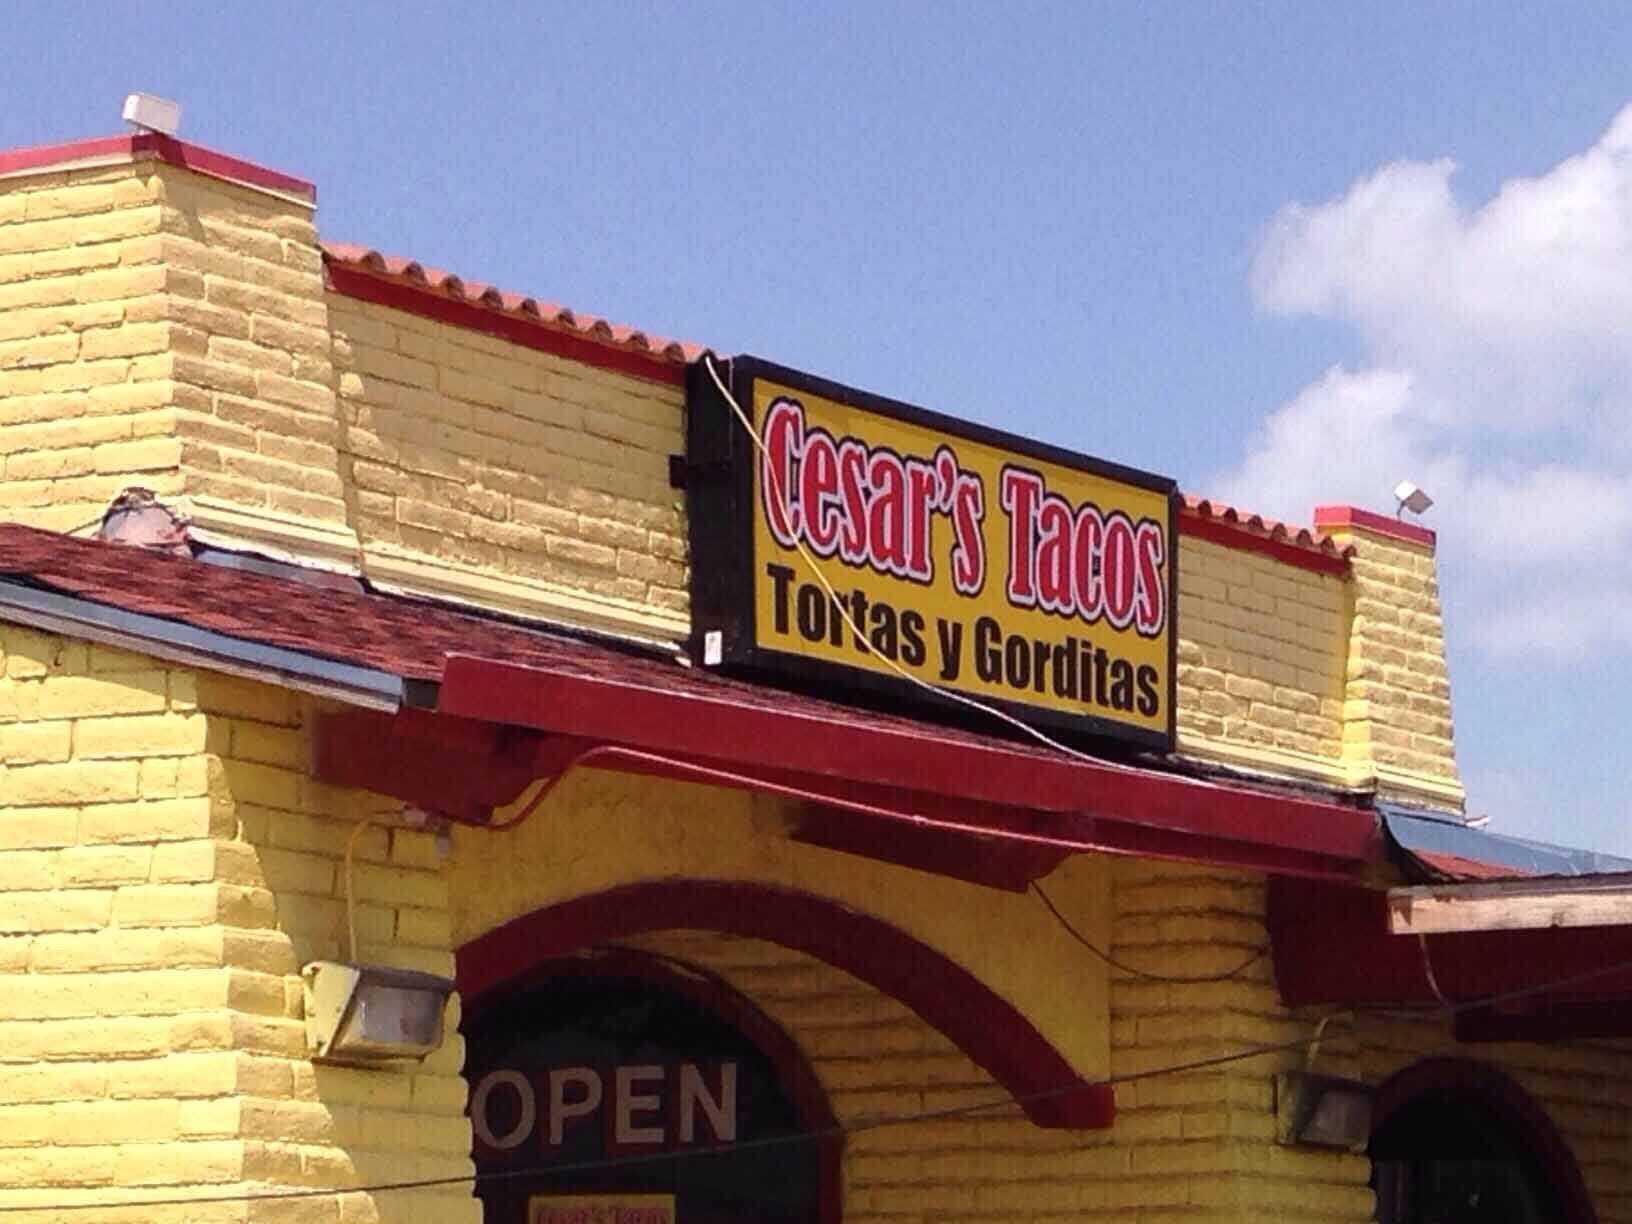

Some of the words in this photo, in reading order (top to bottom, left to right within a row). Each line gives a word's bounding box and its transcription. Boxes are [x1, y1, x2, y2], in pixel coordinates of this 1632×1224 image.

[762, 398, 984, 594] Cesar's
[1001, 466, 1164, 636] Tacos
[767, 563, 926, 667] Tortas
[937, 610, 963, 681] y
[974, 616, 1159, 717] Gorditas
[472, 1063, 737, 1150] OPEN
